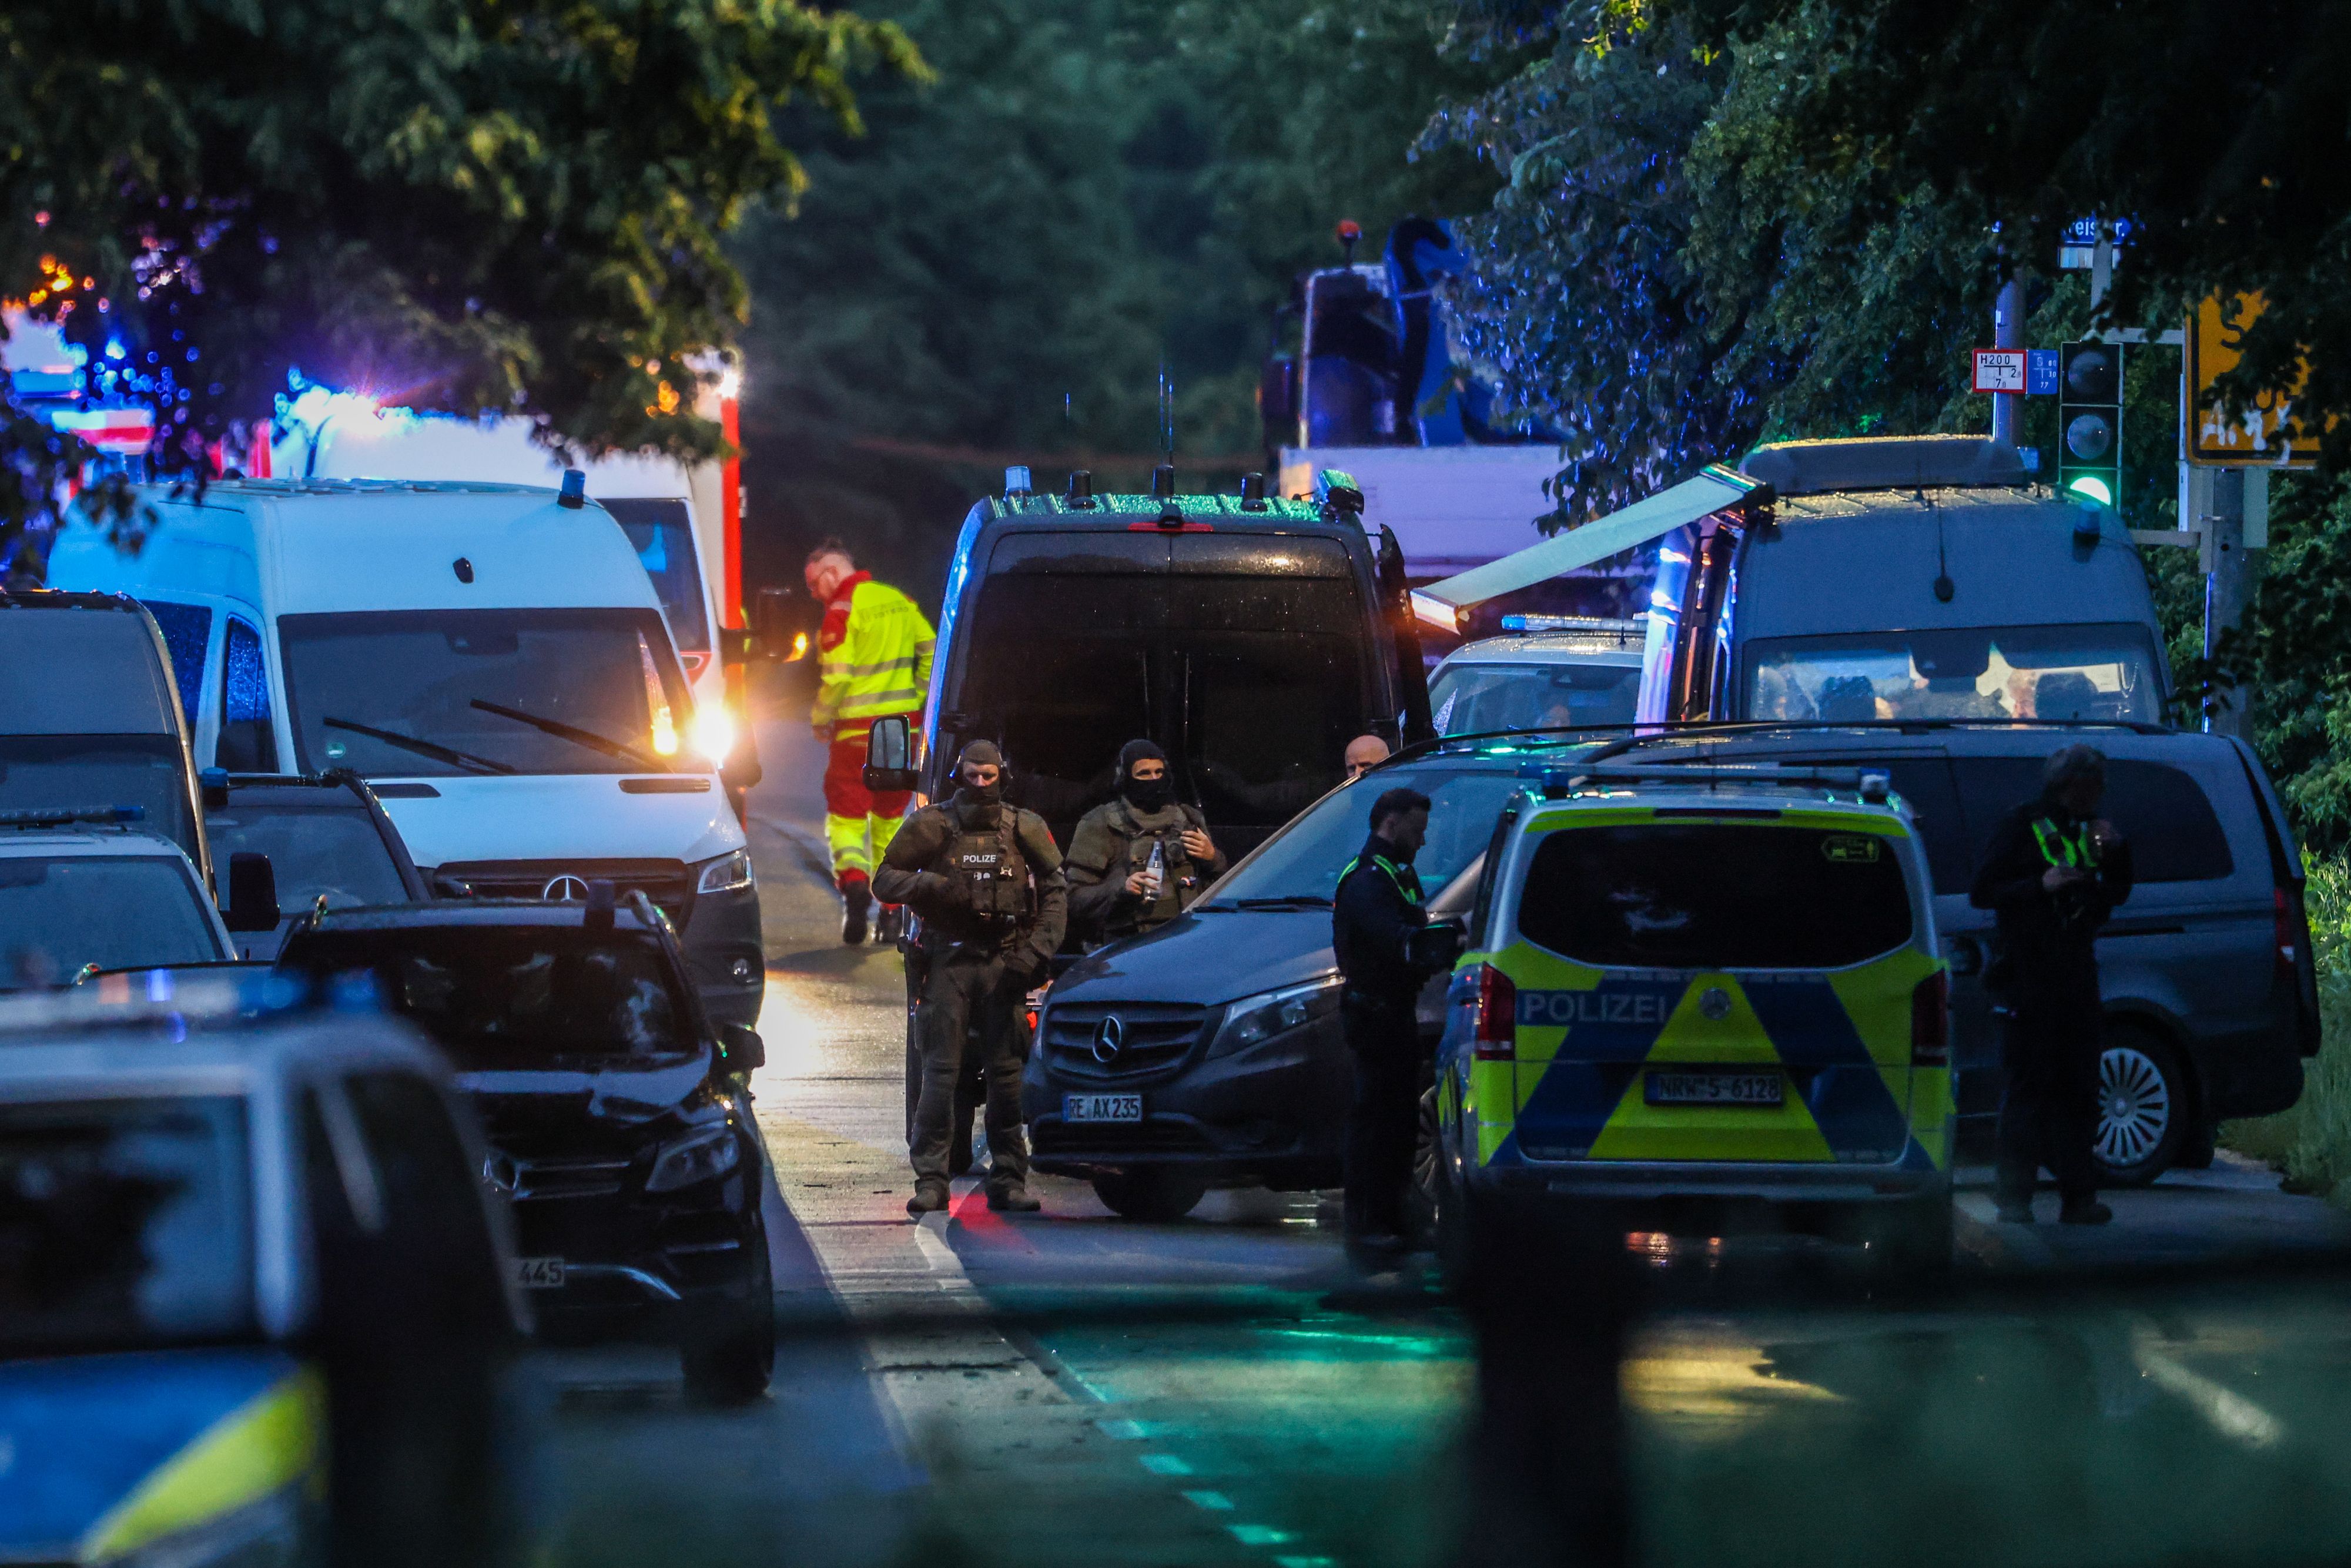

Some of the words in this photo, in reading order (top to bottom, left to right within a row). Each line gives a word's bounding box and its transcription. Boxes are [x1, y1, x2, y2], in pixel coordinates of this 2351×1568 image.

[1981, 354, 2010, 365] H200
[963, 855, 996, 863] POLIZE
[1523, 993, 1666, 1023] POLIZEI
[1069, 1098, 1084, 1118] RE
